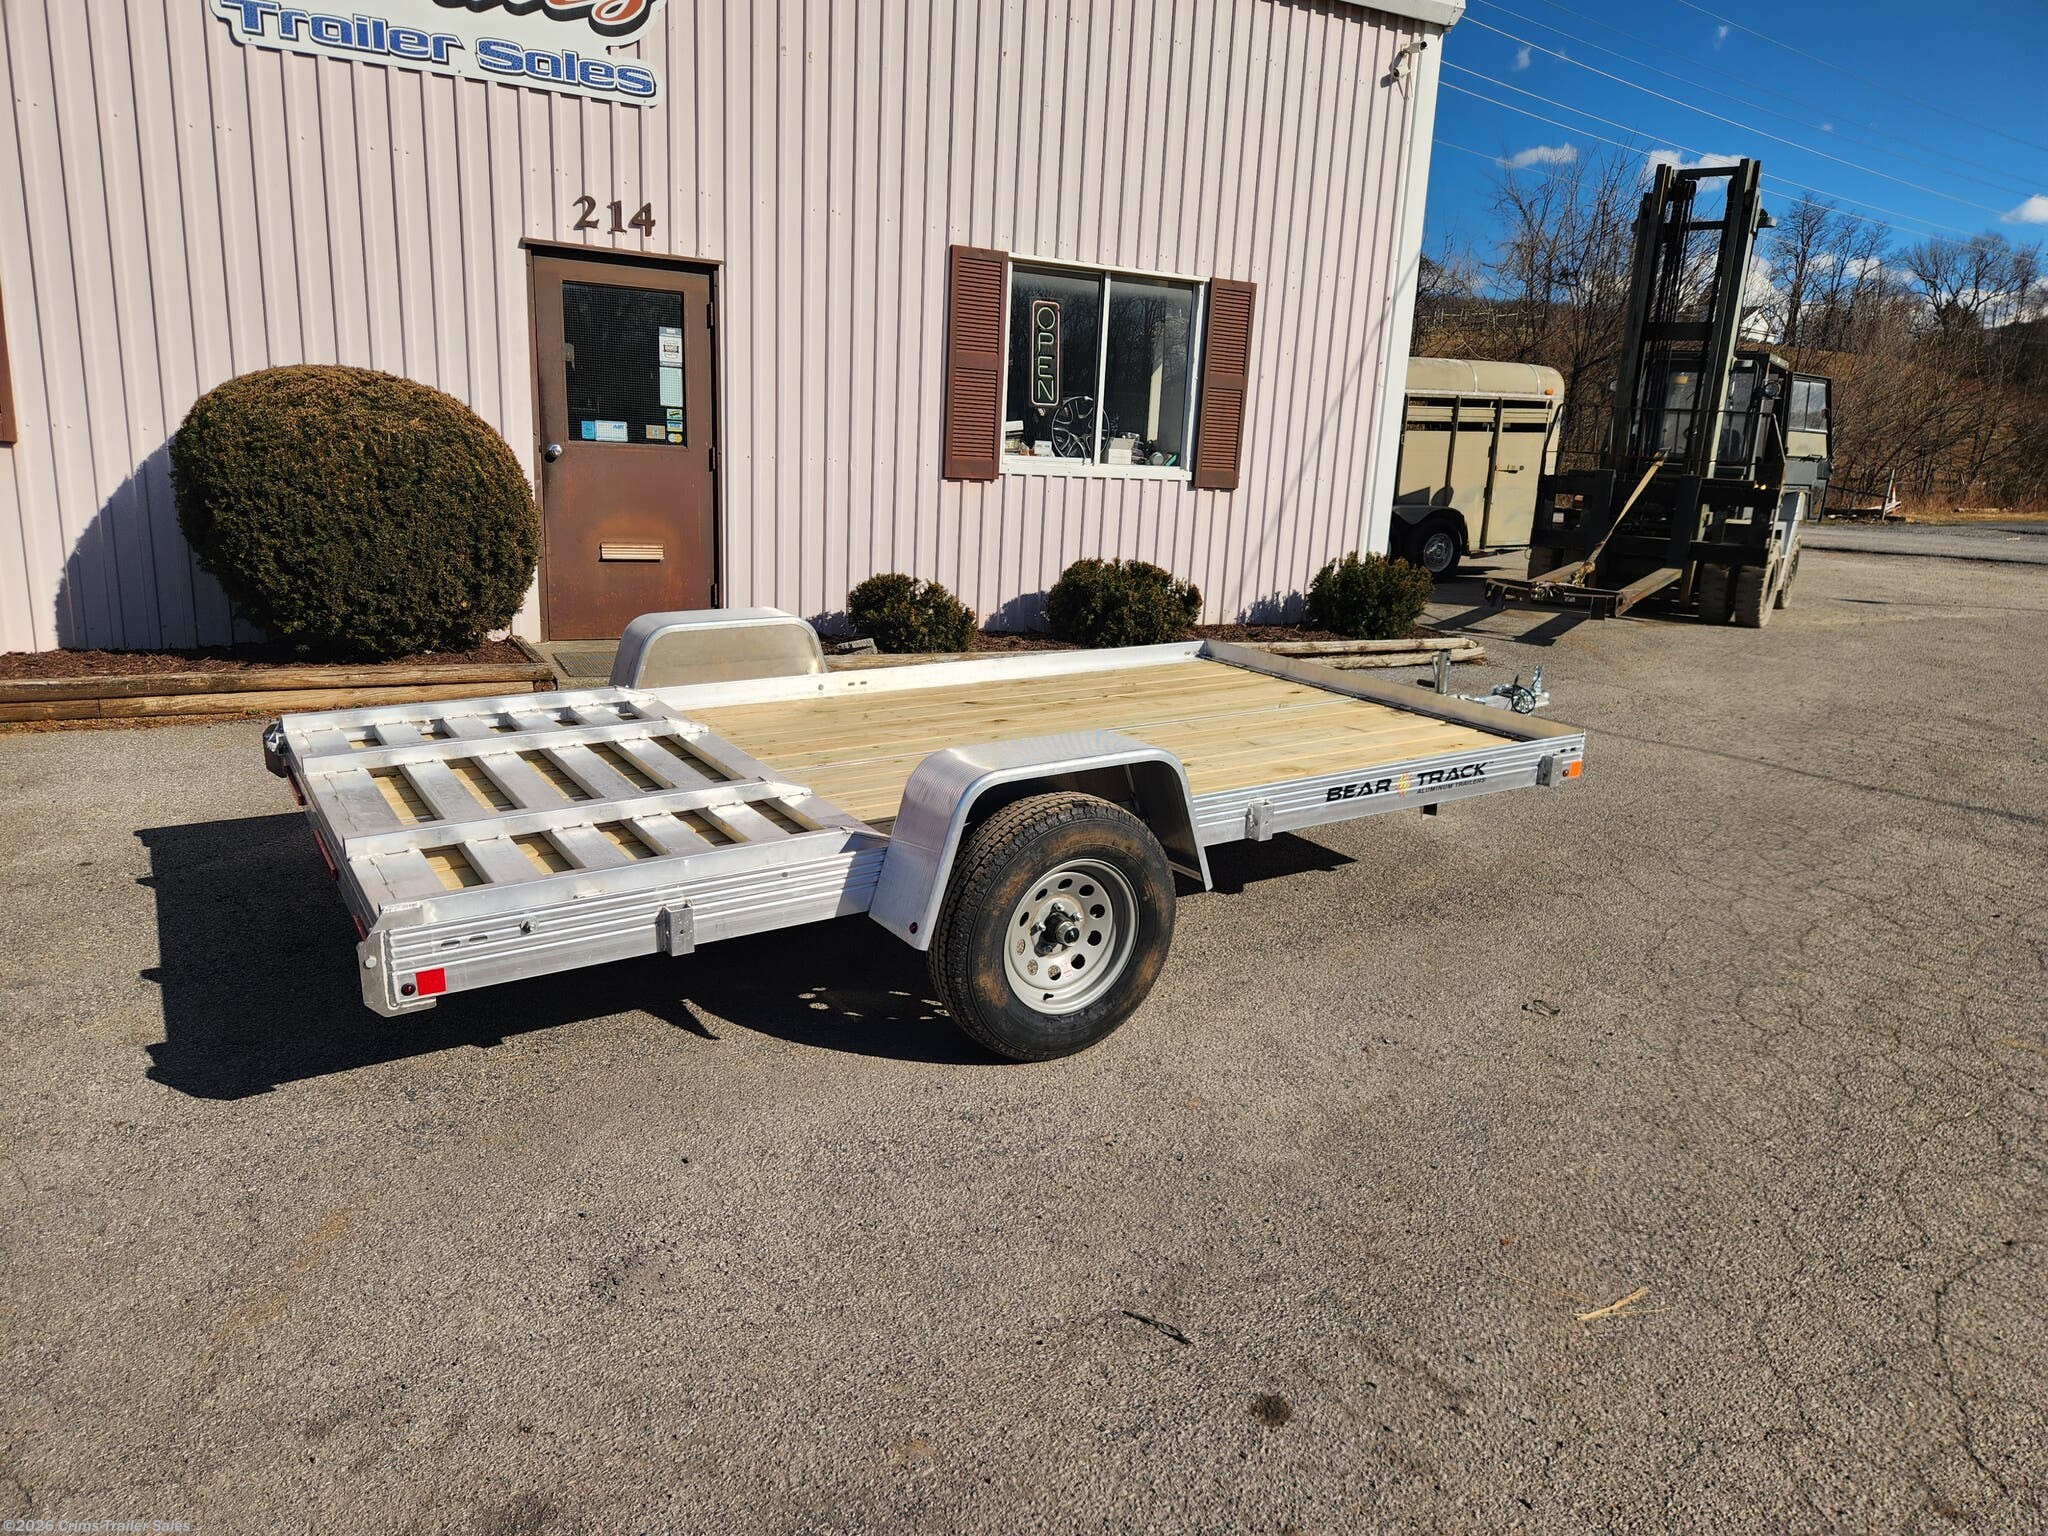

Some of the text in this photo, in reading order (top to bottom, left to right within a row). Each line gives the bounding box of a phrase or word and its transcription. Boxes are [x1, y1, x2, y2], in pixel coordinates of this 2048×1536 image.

[220, 0, 463, 64] Trailer
[476, 37, 656, 97] Sales
[573, 195, 656, 237] 214
[1036, 306, 1055, 400] OPEN
[1326, 762, 1488, 802] BEAR TRACK
[1416, 778, 1487, 794] ALUMINUM TRAILERS
